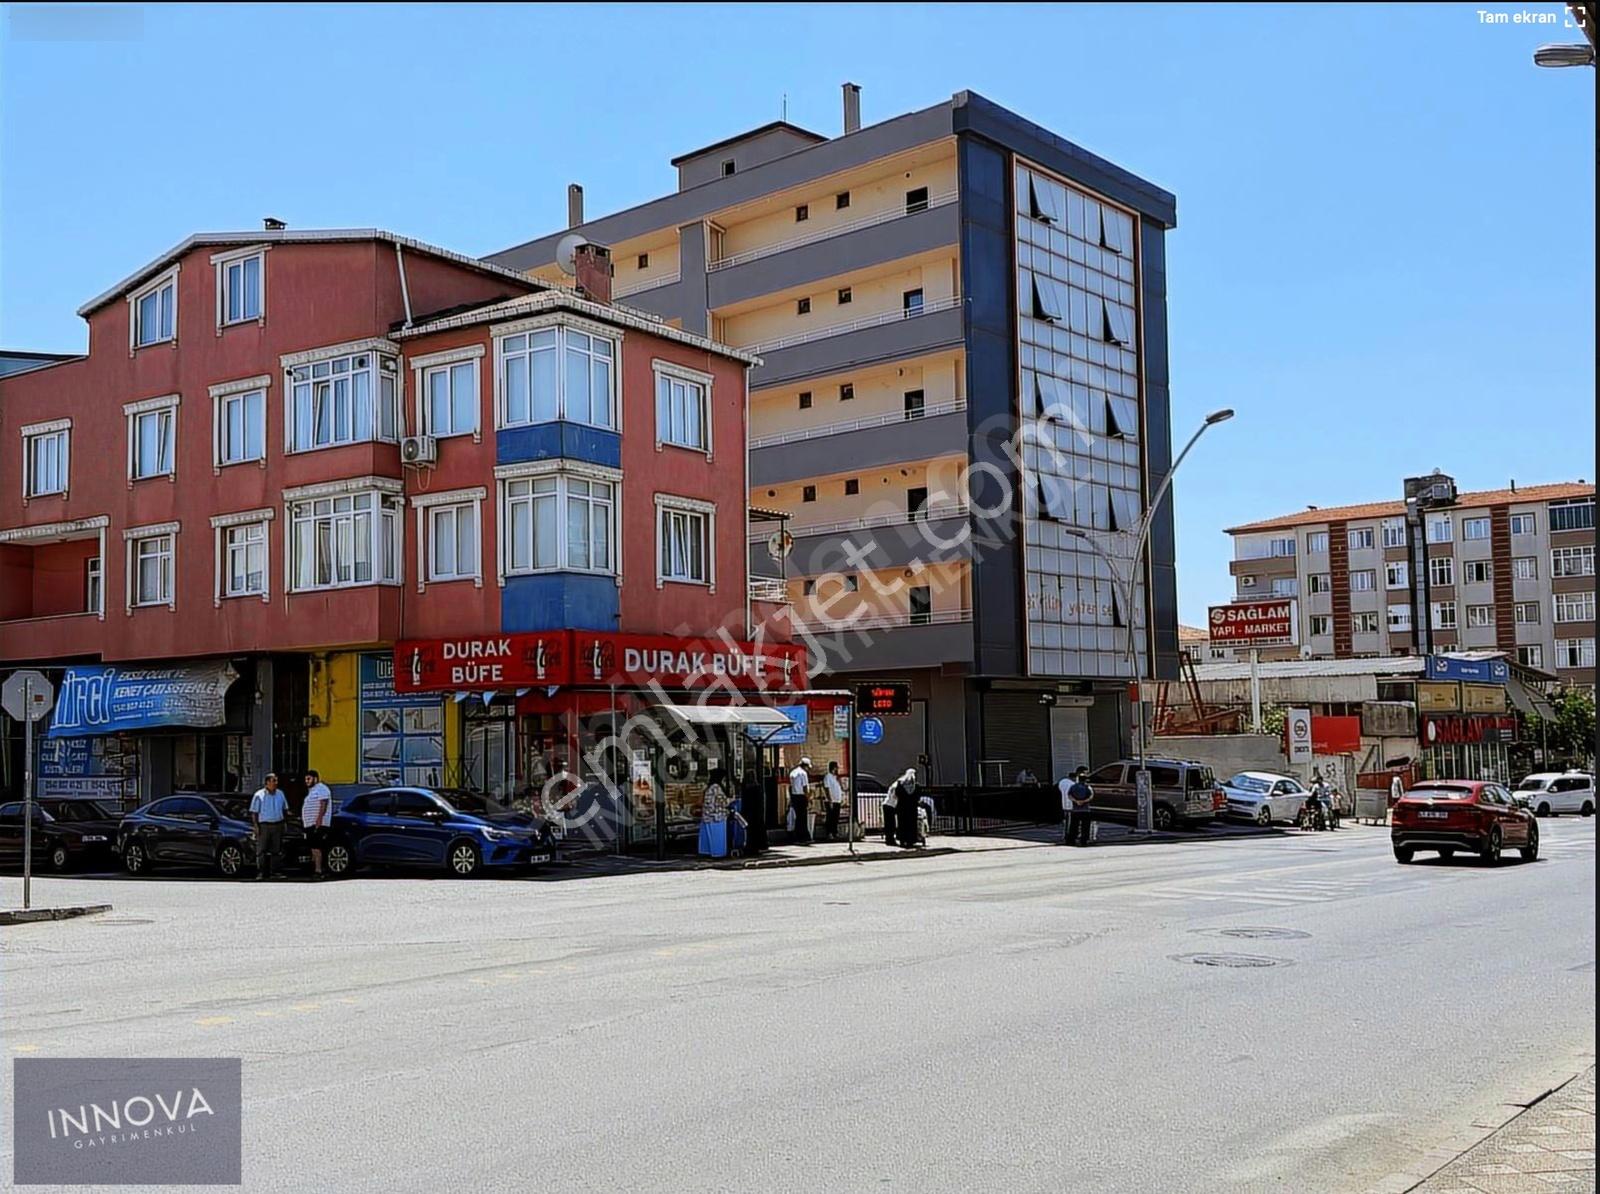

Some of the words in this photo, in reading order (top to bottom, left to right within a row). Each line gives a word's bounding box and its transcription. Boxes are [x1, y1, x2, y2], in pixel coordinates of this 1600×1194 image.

[1227, 605, 1290, 622] SAĞLAM
[1211, 625, 1236, 637] YAPI
[1244, 622, 1291, 635] MARKET
[443, 638, 512, 660] DURAK
[451, 661, 504, 684] BÜFE
[624, 648, 706, 675] DURAK
[713, 648, 767, 677] BÜFE
